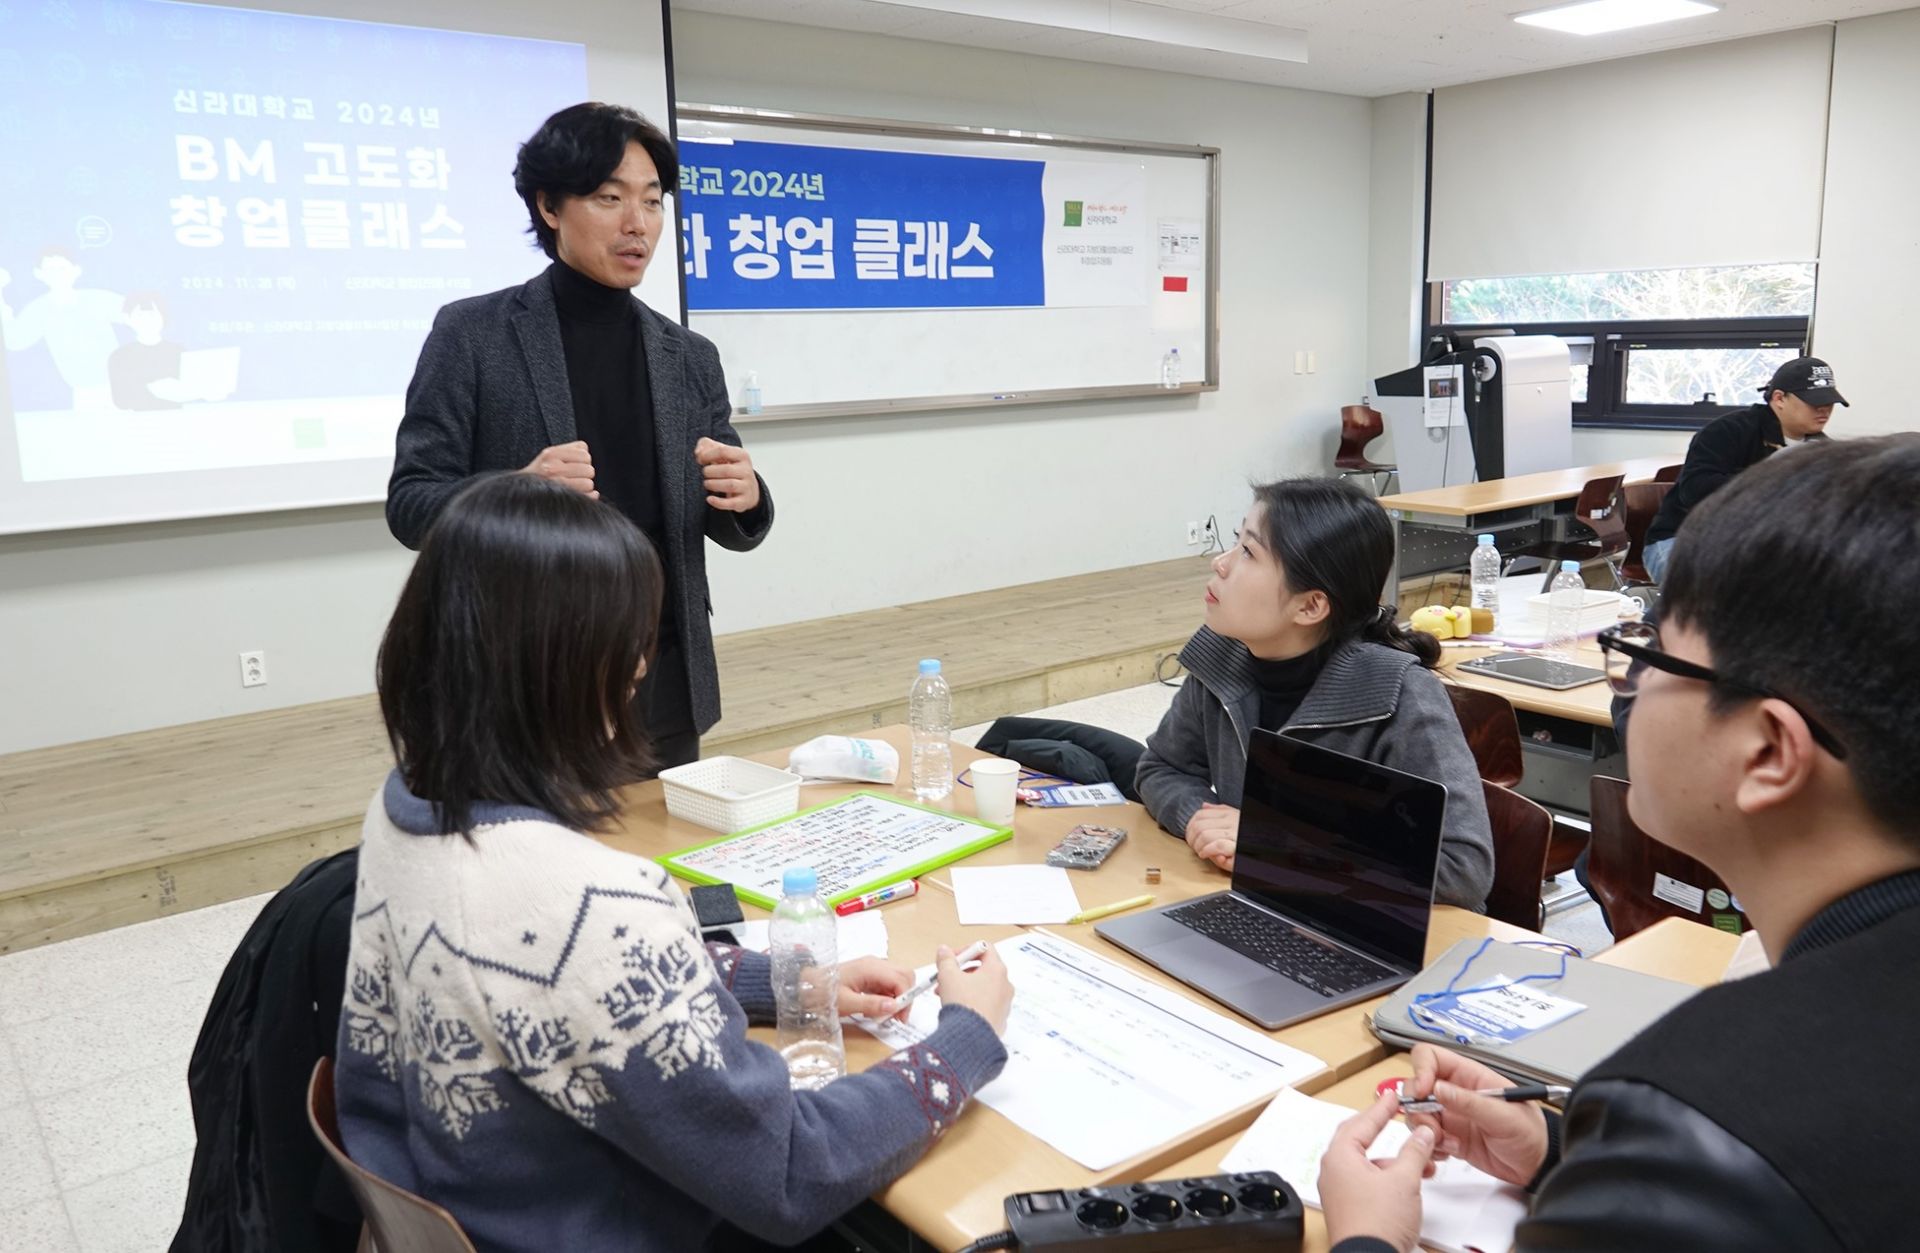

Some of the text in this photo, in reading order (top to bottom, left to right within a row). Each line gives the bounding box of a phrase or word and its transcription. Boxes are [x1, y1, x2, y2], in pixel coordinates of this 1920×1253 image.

[174, 89, 440, 129] 신라대학교 2024년
[175, 134, 452, 191] BM 고도화
[730, 168, 825, 201] 2024년
[728, 213, 835, 279] 창업
[853, 218, 994, 280] 클래스
